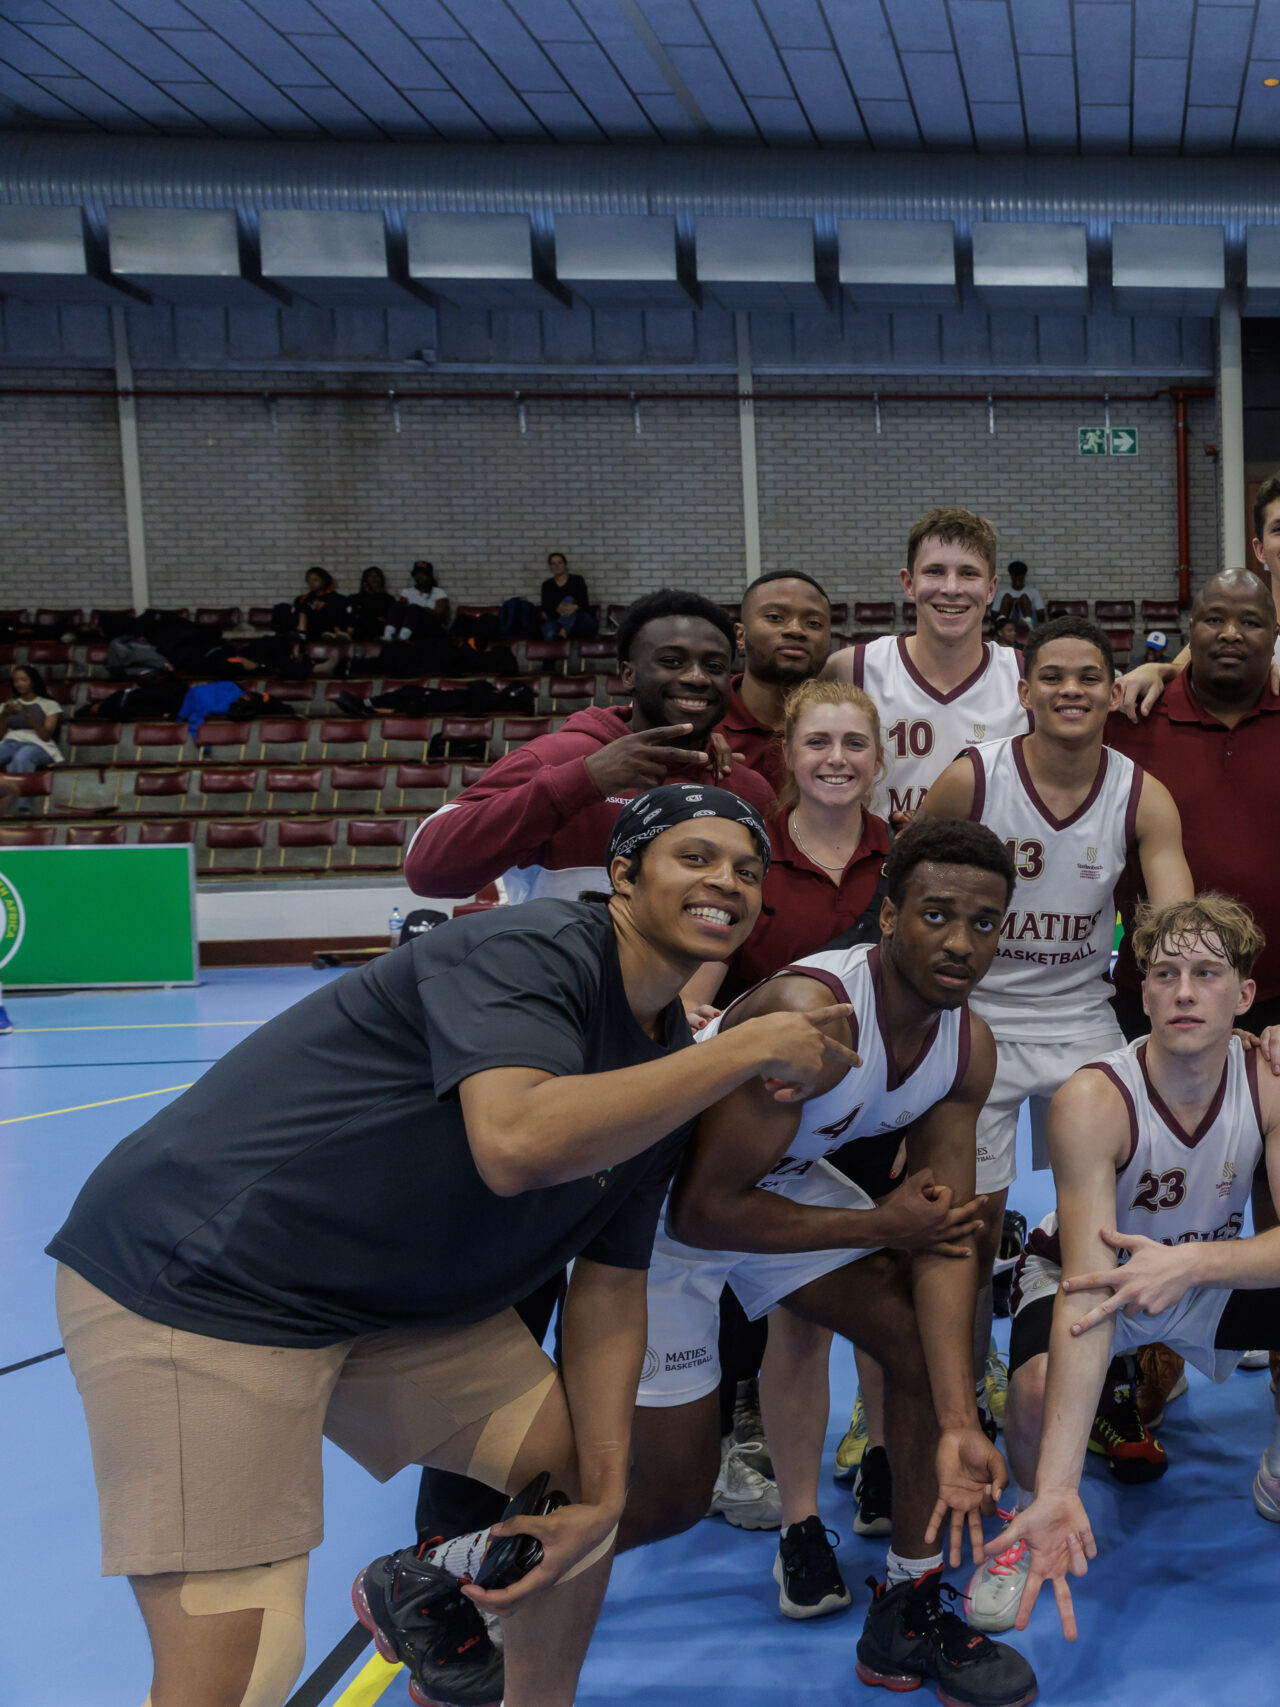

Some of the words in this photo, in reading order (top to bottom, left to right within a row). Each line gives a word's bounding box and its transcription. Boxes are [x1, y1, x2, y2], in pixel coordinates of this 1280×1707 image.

[887, 718, 936, 759] 10
[4, 899, 17, 939] AFRICA
[812, 1102, 865, 1141] 4
[1128, 1166, 1187, 1214] 23
[665, 1346, 707, 1363] MATIES
[665, 1355, 713, 1372] BASKETBALL
